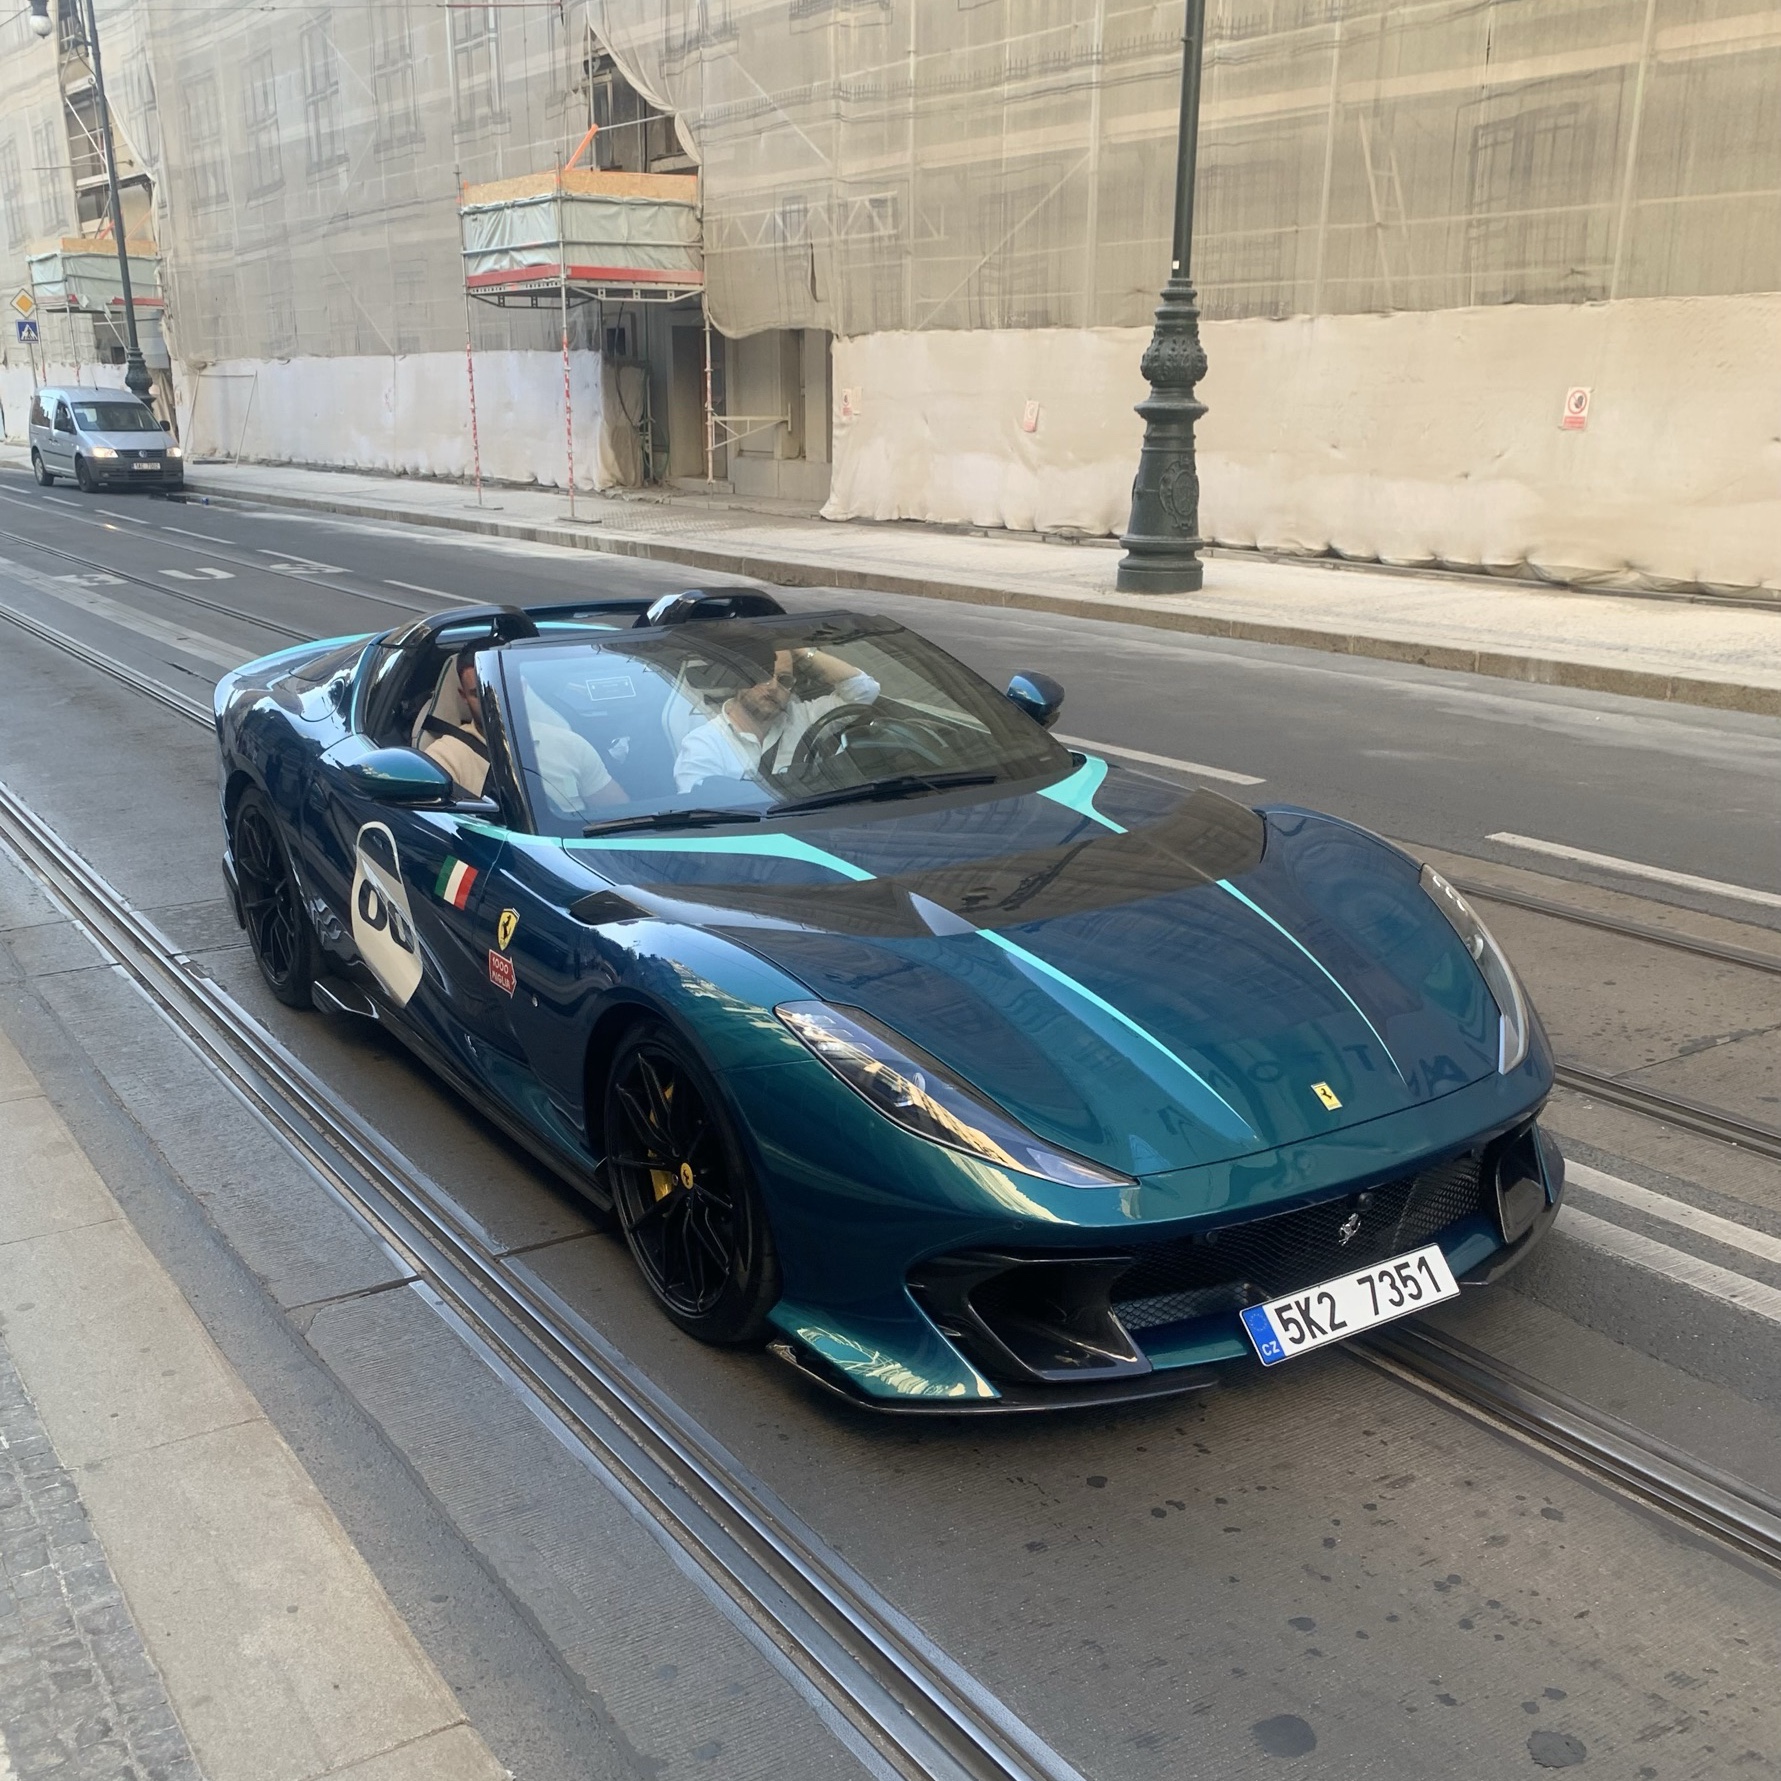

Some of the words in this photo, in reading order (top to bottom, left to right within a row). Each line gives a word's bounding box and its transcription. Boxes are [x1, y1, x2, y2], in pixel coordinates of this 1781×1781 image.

[492, 956, 509, 975] 1000
[491, 970, 511, 990] MIGLIA
[1274, 1291, 1347, 1345] 5K2
[1356, 1256, 1442, 1316] 7351
[1262, 1340, 1280, 1357] CZ
